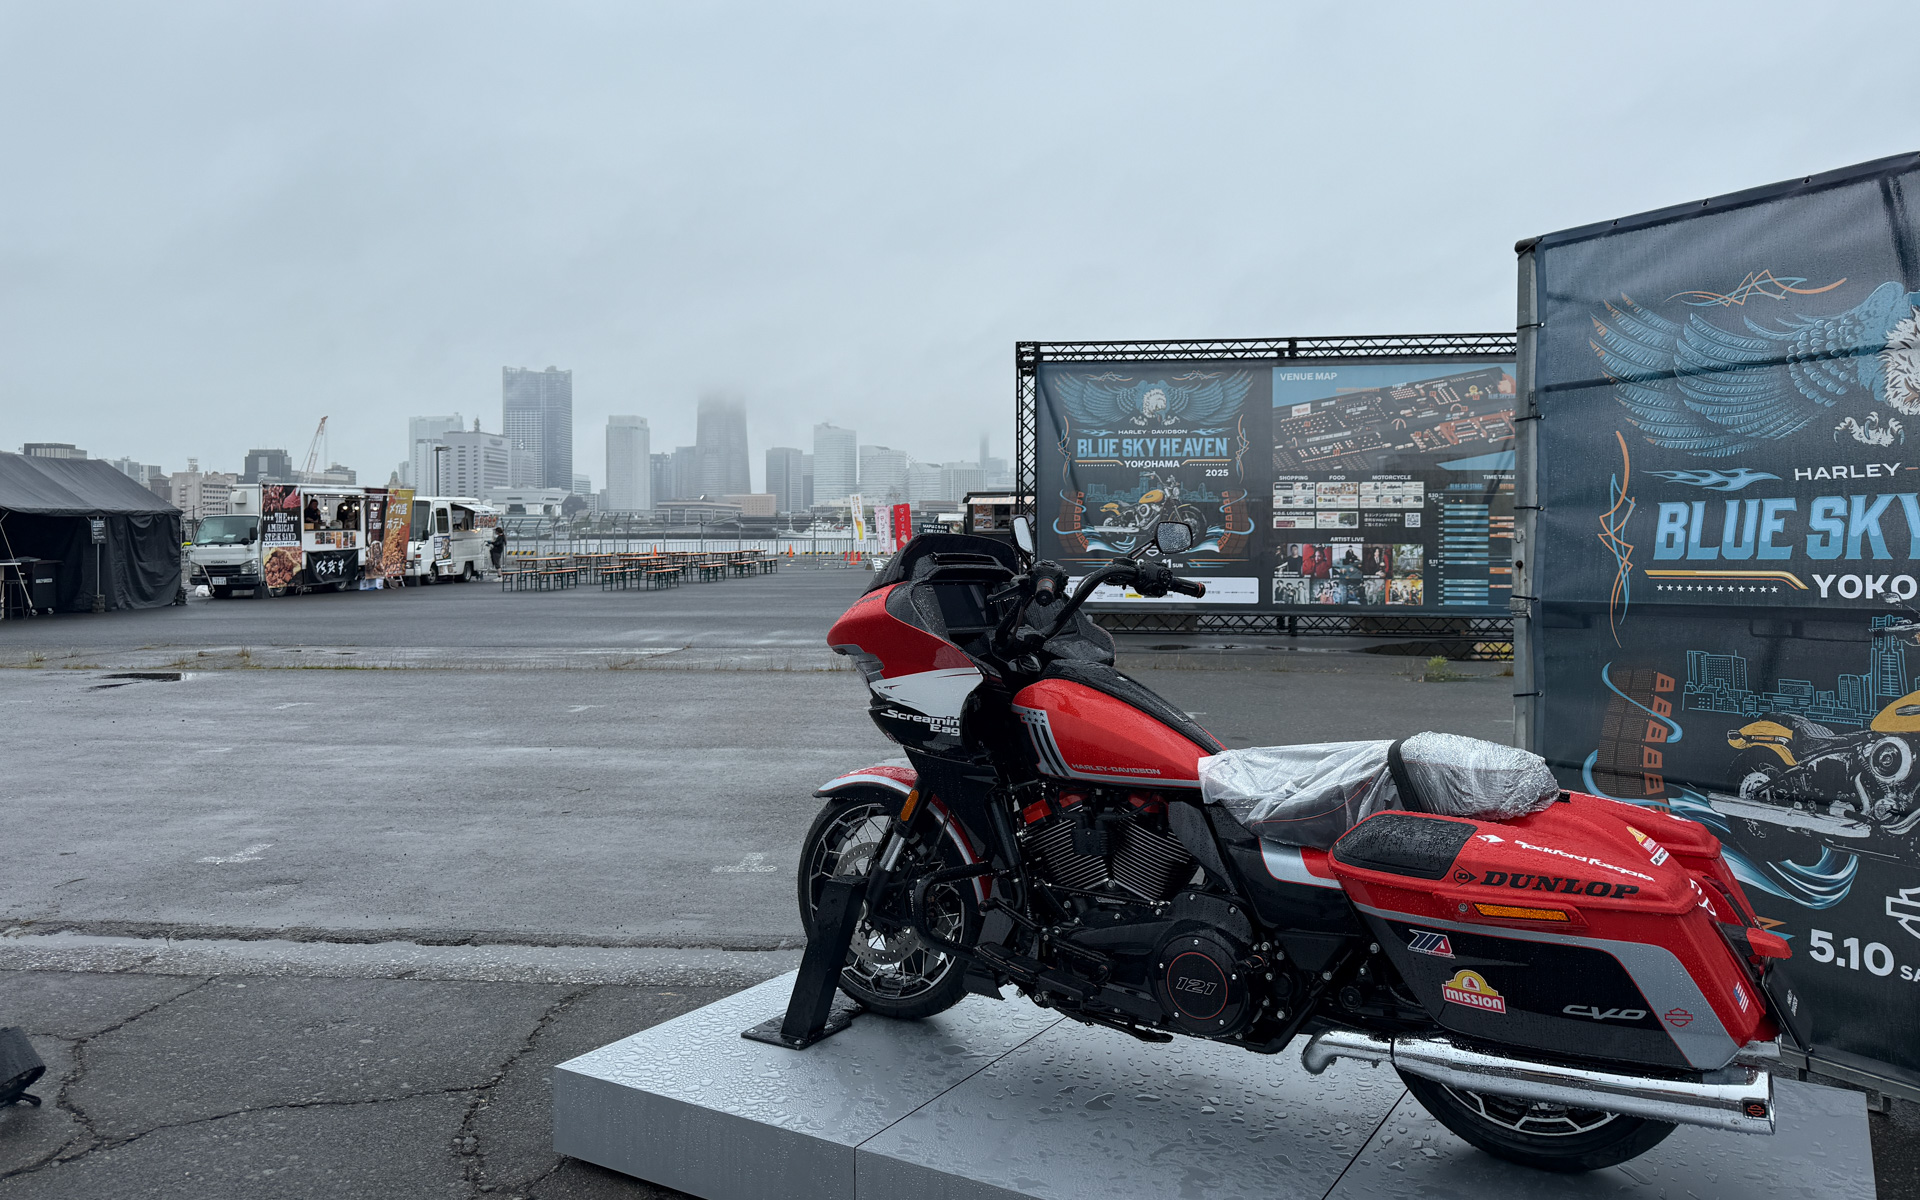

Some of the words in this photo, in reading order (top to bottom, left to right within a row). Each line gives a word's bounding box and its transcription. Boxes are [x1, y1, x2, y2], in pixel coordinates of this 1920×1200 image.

[1315, 372, 1337, 380] MAP
[1077, 438, 1119, 458] BLUE
[1122, 438, 1157, 457] SKY
[1159, 437, 1228, 457] HEAVEN
[1124, 460, 1180, 468] YOKOHAMA
[1205, 469, 1229, 477] 2025
[275, 512, 287, 523] THE
[1653, 497, 1797, 560] BLUE
[1811, 574, 1918, 600] YOKO
[929, 723, 961, 737] Eag
[1071, 763, 1161, 775] HARLEY-DAVIDSON
[1480, 869, 1640, 899] DUNLOP
[1809, 928, 1895, 977] 5.10
[1175, 976, 1218, 996] 121
[1562, 1004, 1648, 1020] CVO
